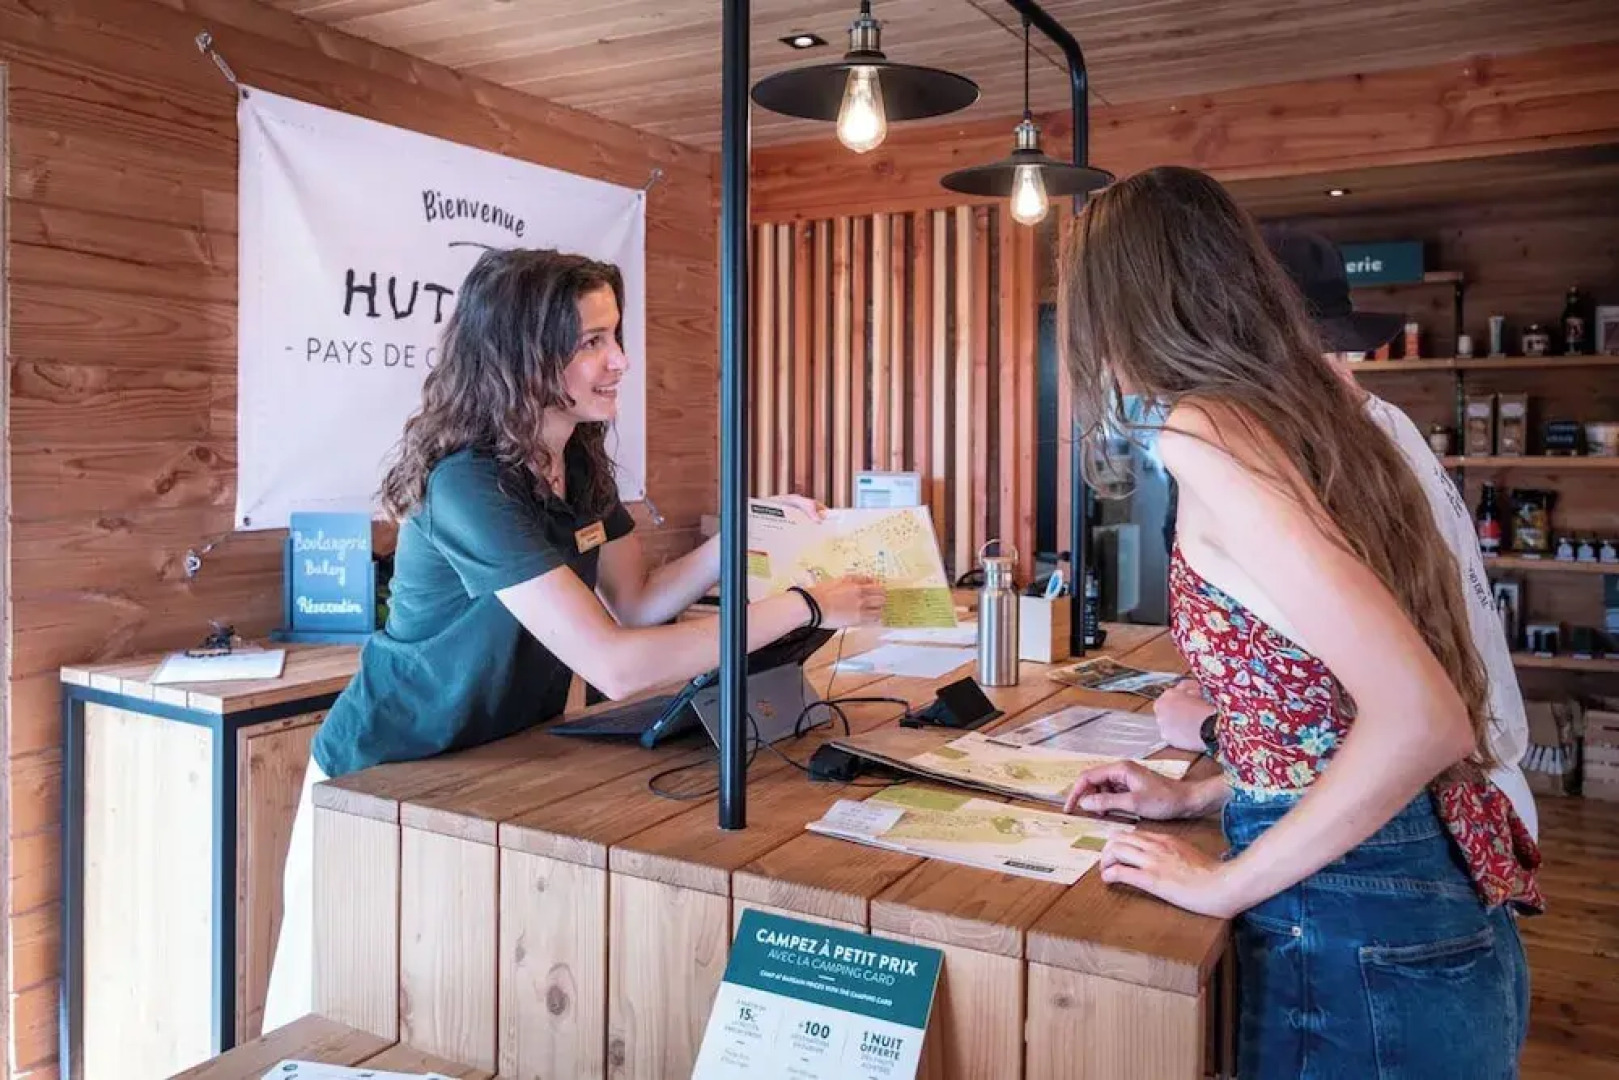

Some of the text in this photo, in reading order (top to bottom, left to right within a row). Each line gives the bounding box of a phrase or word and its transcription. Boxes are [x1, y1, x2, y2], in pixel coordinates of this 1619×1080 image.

[422, 189, 526, 238] Bienvenue
[306, 337, 373, 368] PAYS
[384, 344, 415, 369] DE
[755, 928, 919, 977] CAMPEZ À PETIT PRIX
[767, 949, 896, 987] AVEC LA CAMPING CARD
[860, 1043, 901, 1061] OFFERTE
[870, 1032, 904, 1050] NUIT
